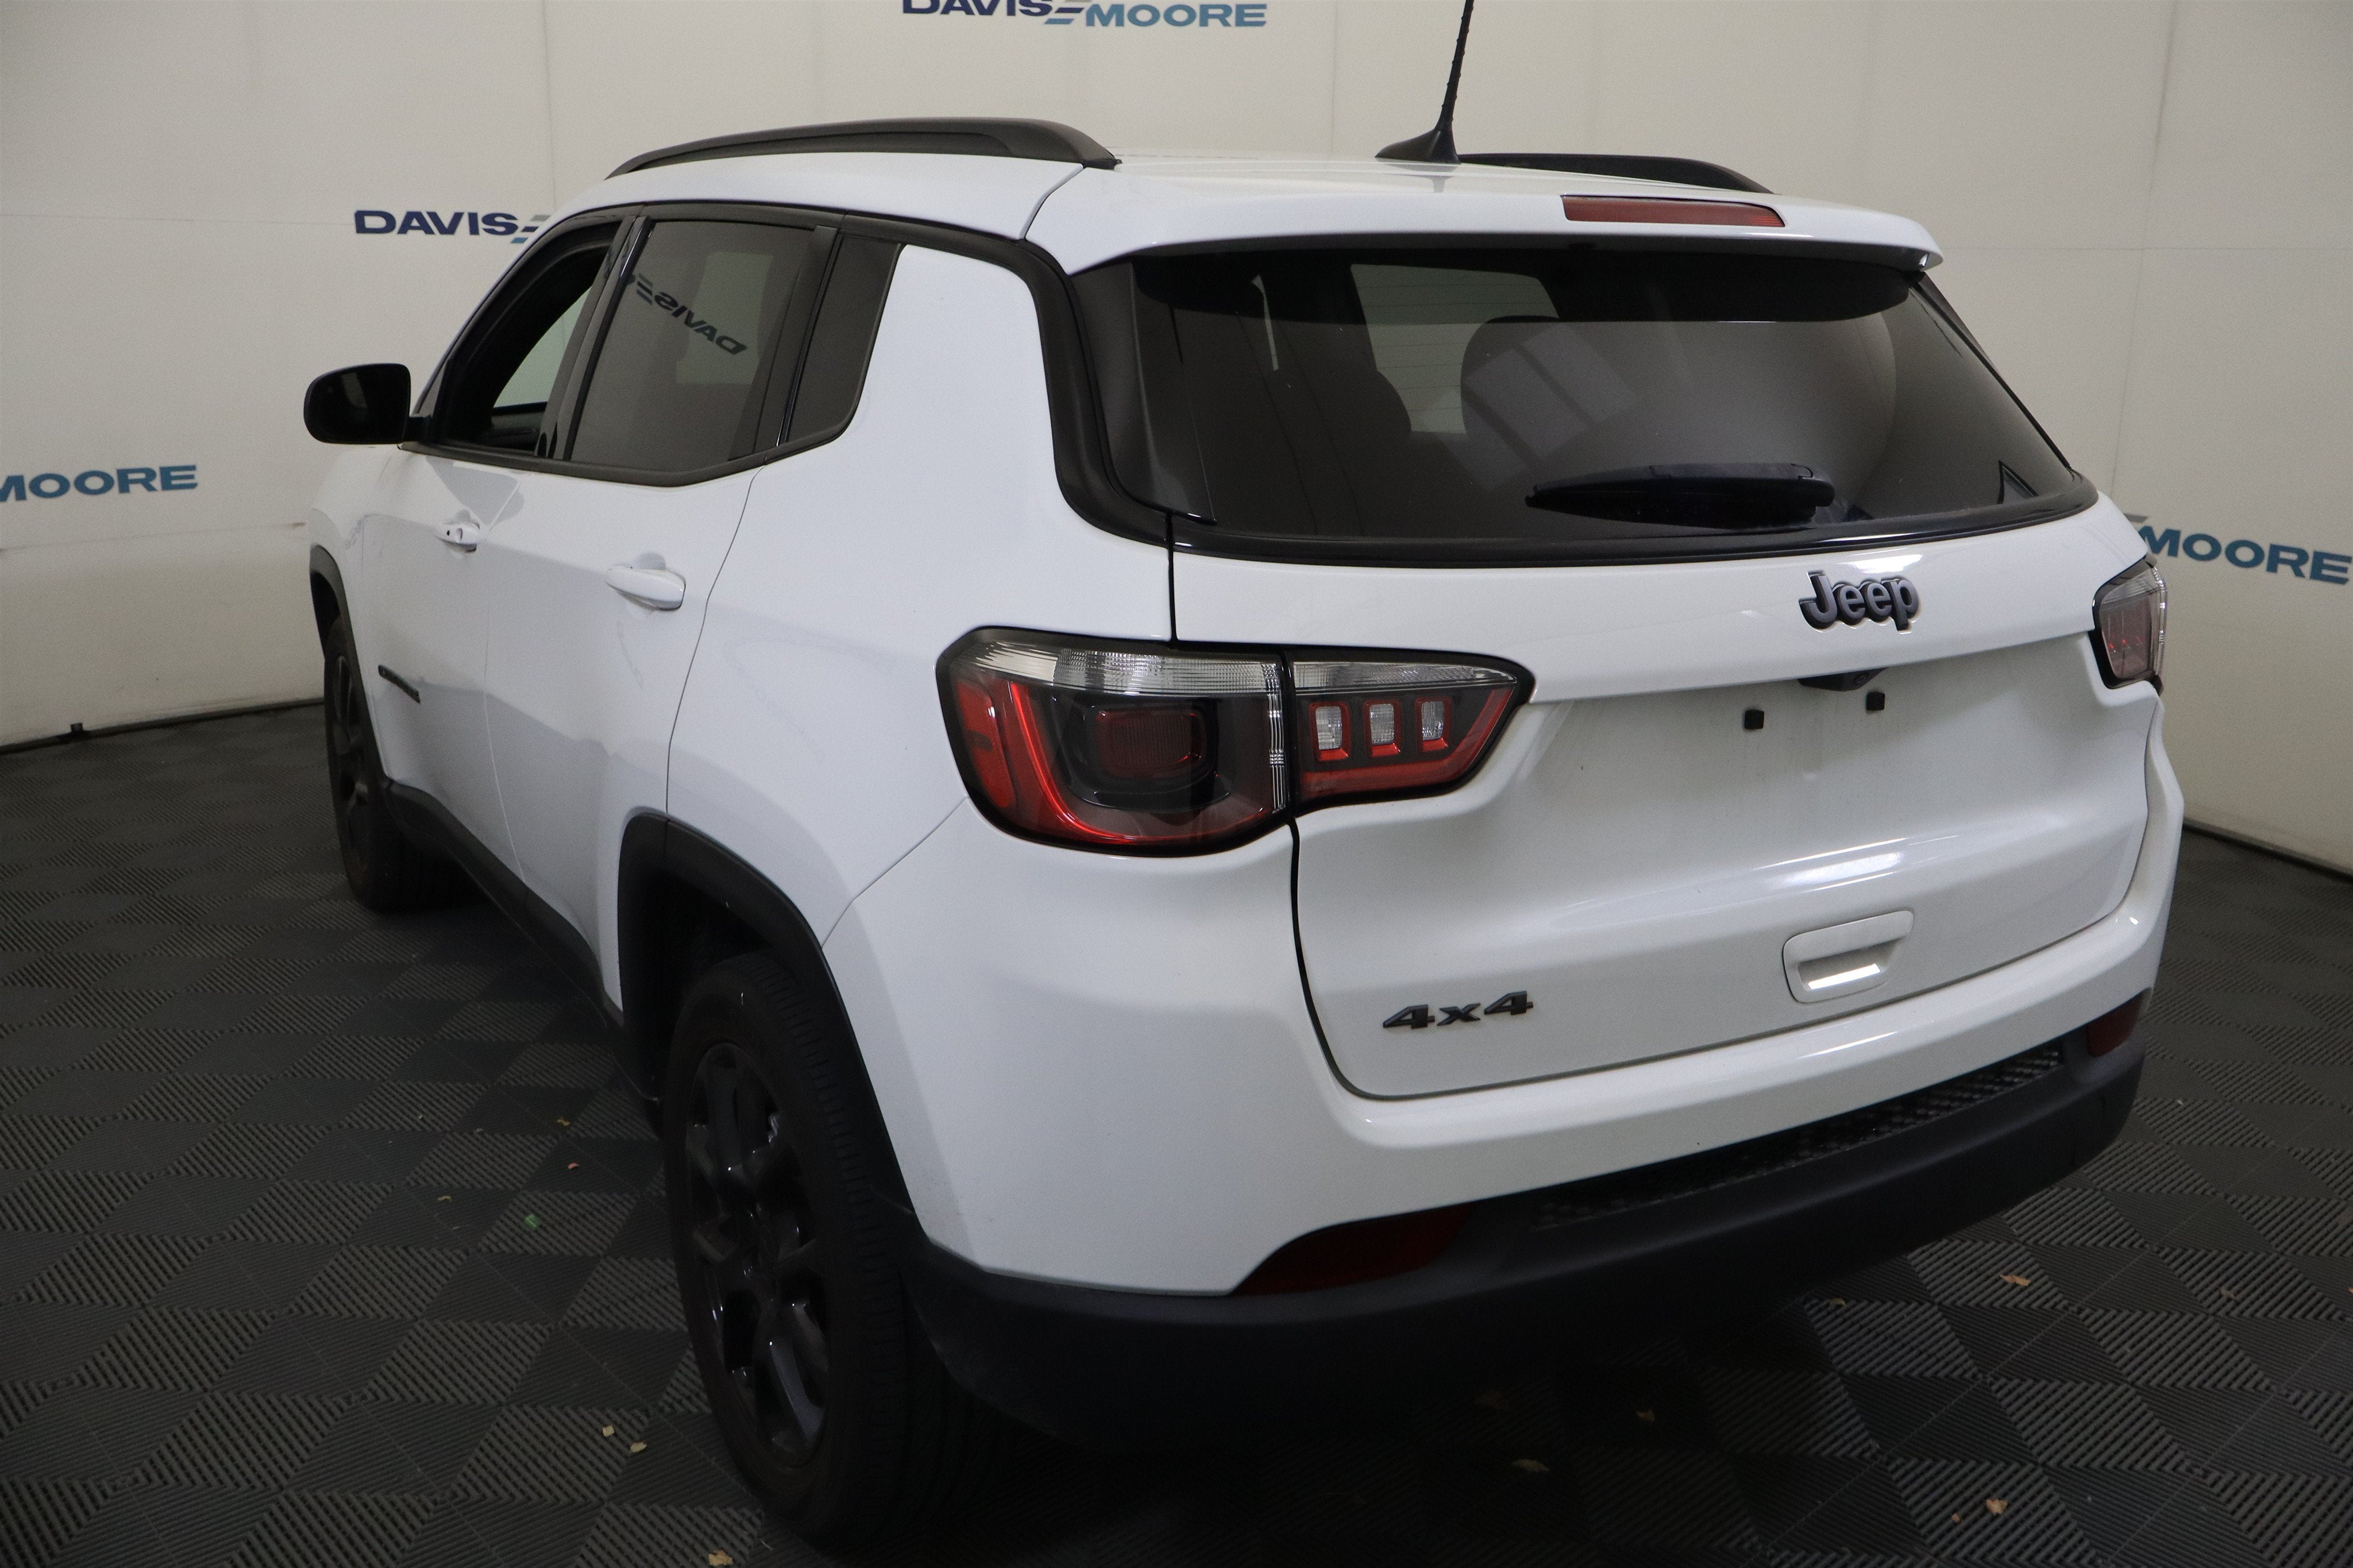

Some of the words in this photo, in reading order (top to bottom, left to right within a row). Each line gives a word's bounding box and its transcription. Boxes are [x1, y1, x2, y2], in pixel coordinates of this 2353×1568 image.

[902, 0, 1054, 16] DAVIS
[1085, 3, 1267, 27] MOORE
[354, 210, 518, 235] DAVIS
[1799, 570, 1920, 631] Jeep
